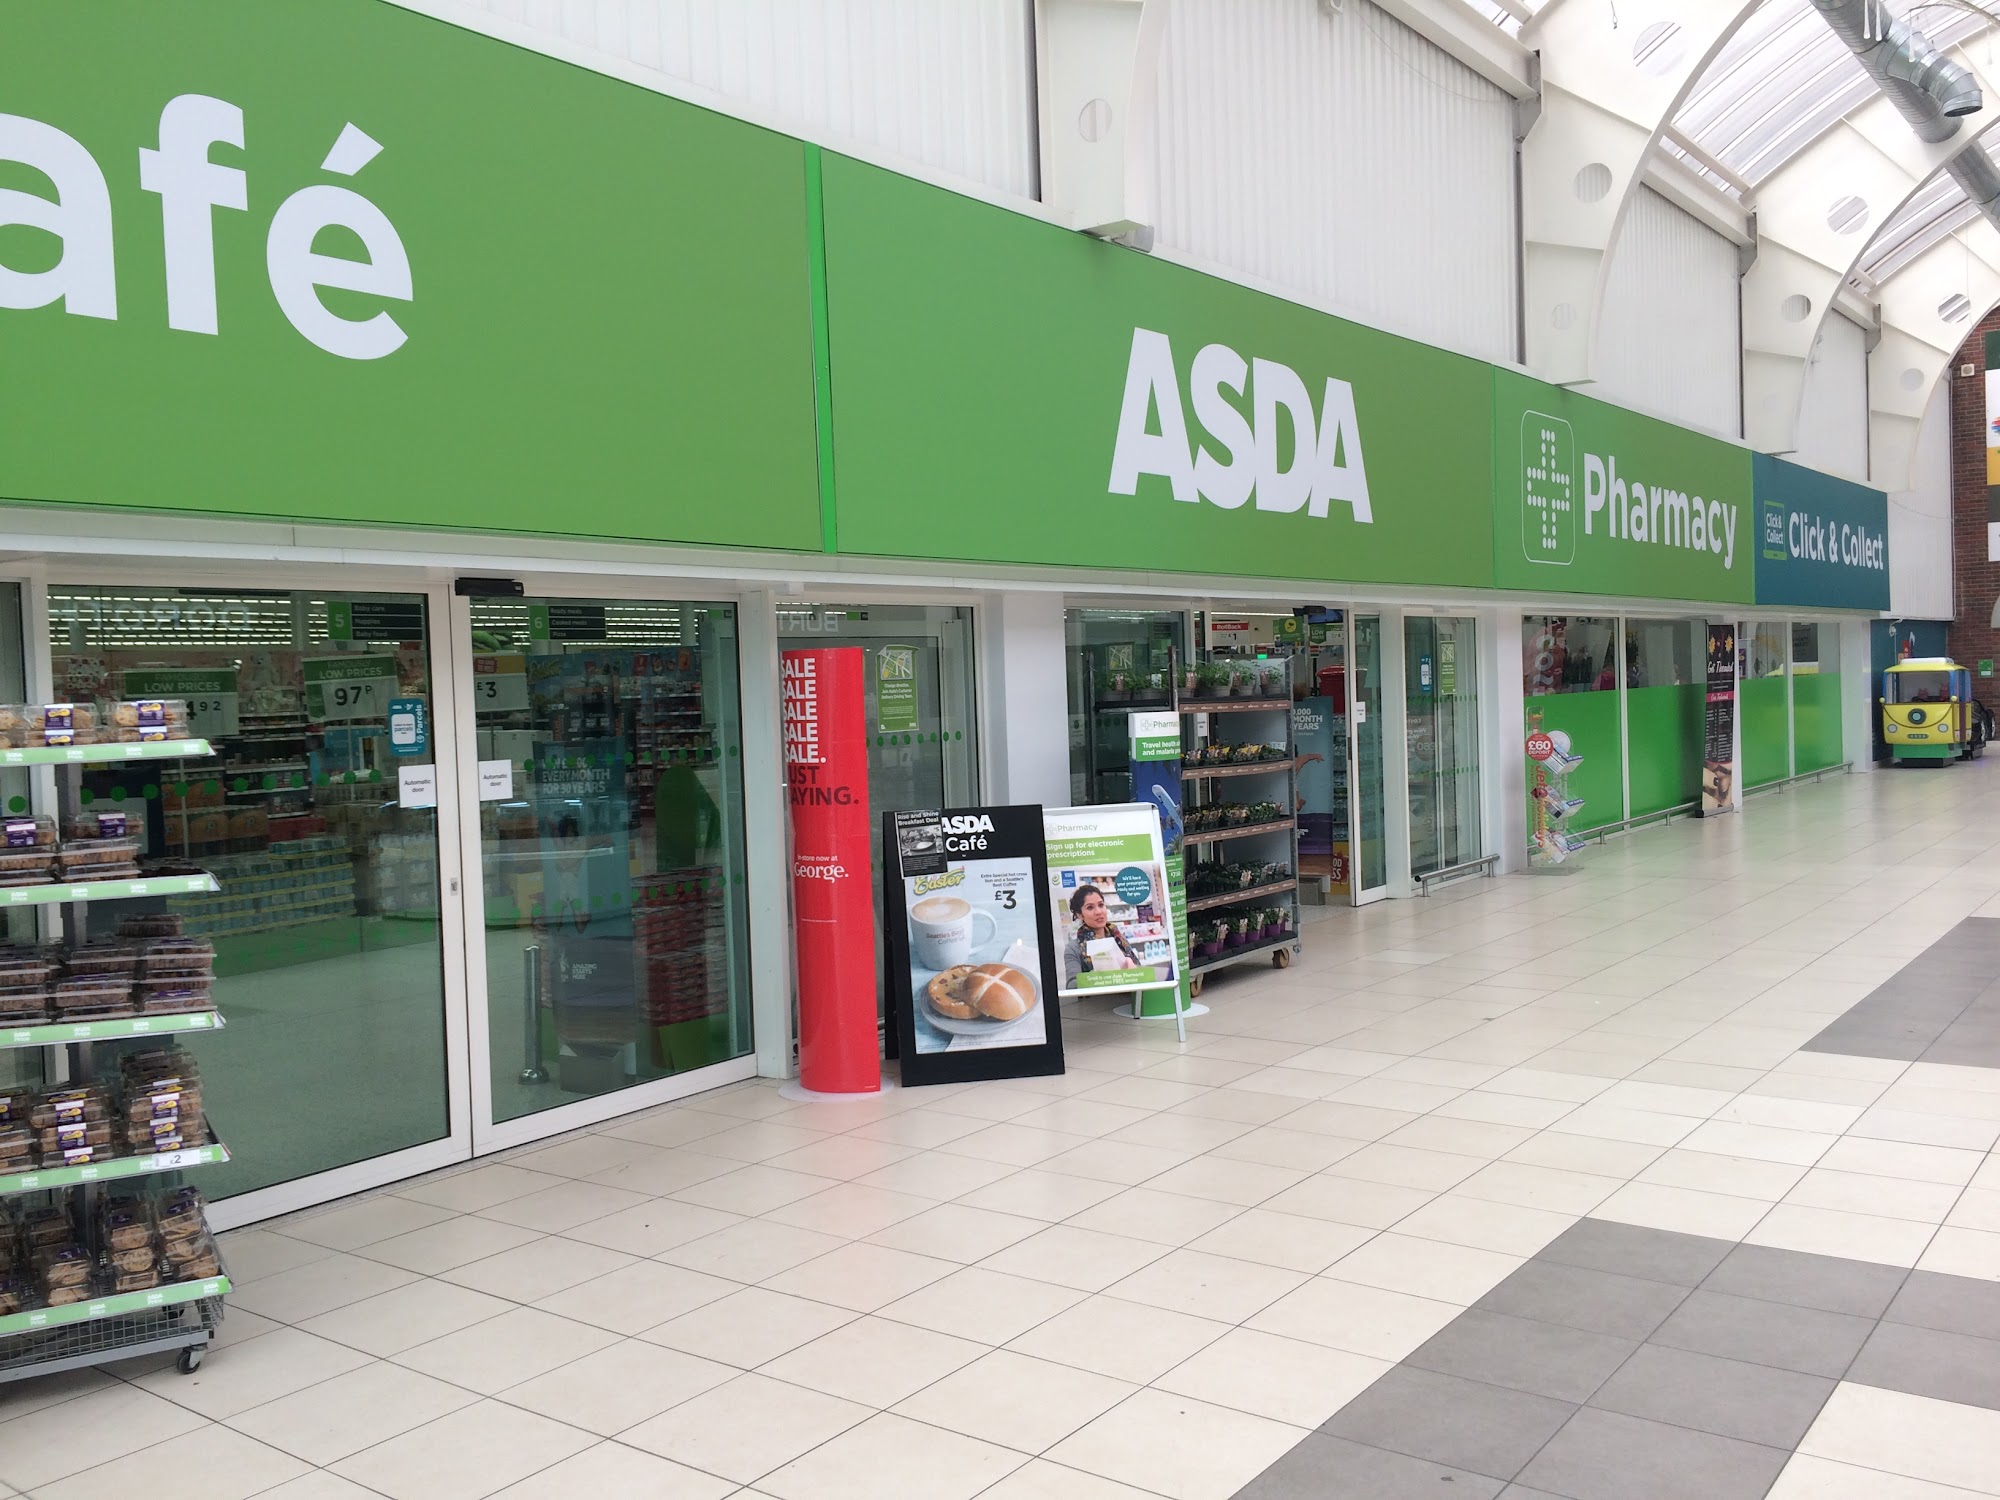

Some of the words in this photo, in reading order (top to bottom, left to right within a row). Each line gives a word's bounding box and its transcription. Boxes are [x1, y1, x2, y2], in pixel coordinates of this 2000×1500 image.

[0, 93, 414, 361] afé
[1108, 326, 1374, 524] ASDA
[1584, 452, 1737, 570] Pharmacy
[1766, 528, 1784, 545] Collect
[1788, 511, 1826, 561] Click
[1828, 520, 1838, 563] &
[1842, 523, 1884, 570] Collect
[354, 604, 371, 613] Baby
[335, 614, 345, 628] 5
[534, 617, 543, 629] 6
[320, 670, 345, 679] LOW
[346, 667, 382, 677] PRICES
[144, 683, 175, 692] LOW
[178, 682, 221, 691] PRICES
[476, 682, 497, 698] £3
[415, 704, 425, 734] Parcels
[1294, 715, 1323, 723] MONTH
[1294, 722, 1319, 730] YEARS
[1528, 740, 1551, 750] £60
[542, 770, 570, 782] EVERY
[571, 768, 611, 781] MONTH
[789, 766, 820, 785] UST
[572, 781, 606, 794] YEARS
[790, 786, 860, 806] AYING.
[898, 818, 925, 826] Breakfast
[942, 815, 995, 834] ASDA
[1058, 824, 1098, 832] Pharmacy
[946, 835, 988, 852] Café
[1046, 842, 1063, 852] Sign
[1065, 843, 1074, 851] up
[1075, 841, 1087, 849] for
[1088, 838, 1124, 848] electronic
[1046, 850, 1096, 860] prescriptions
[995, 890, 1017, 910] £3
